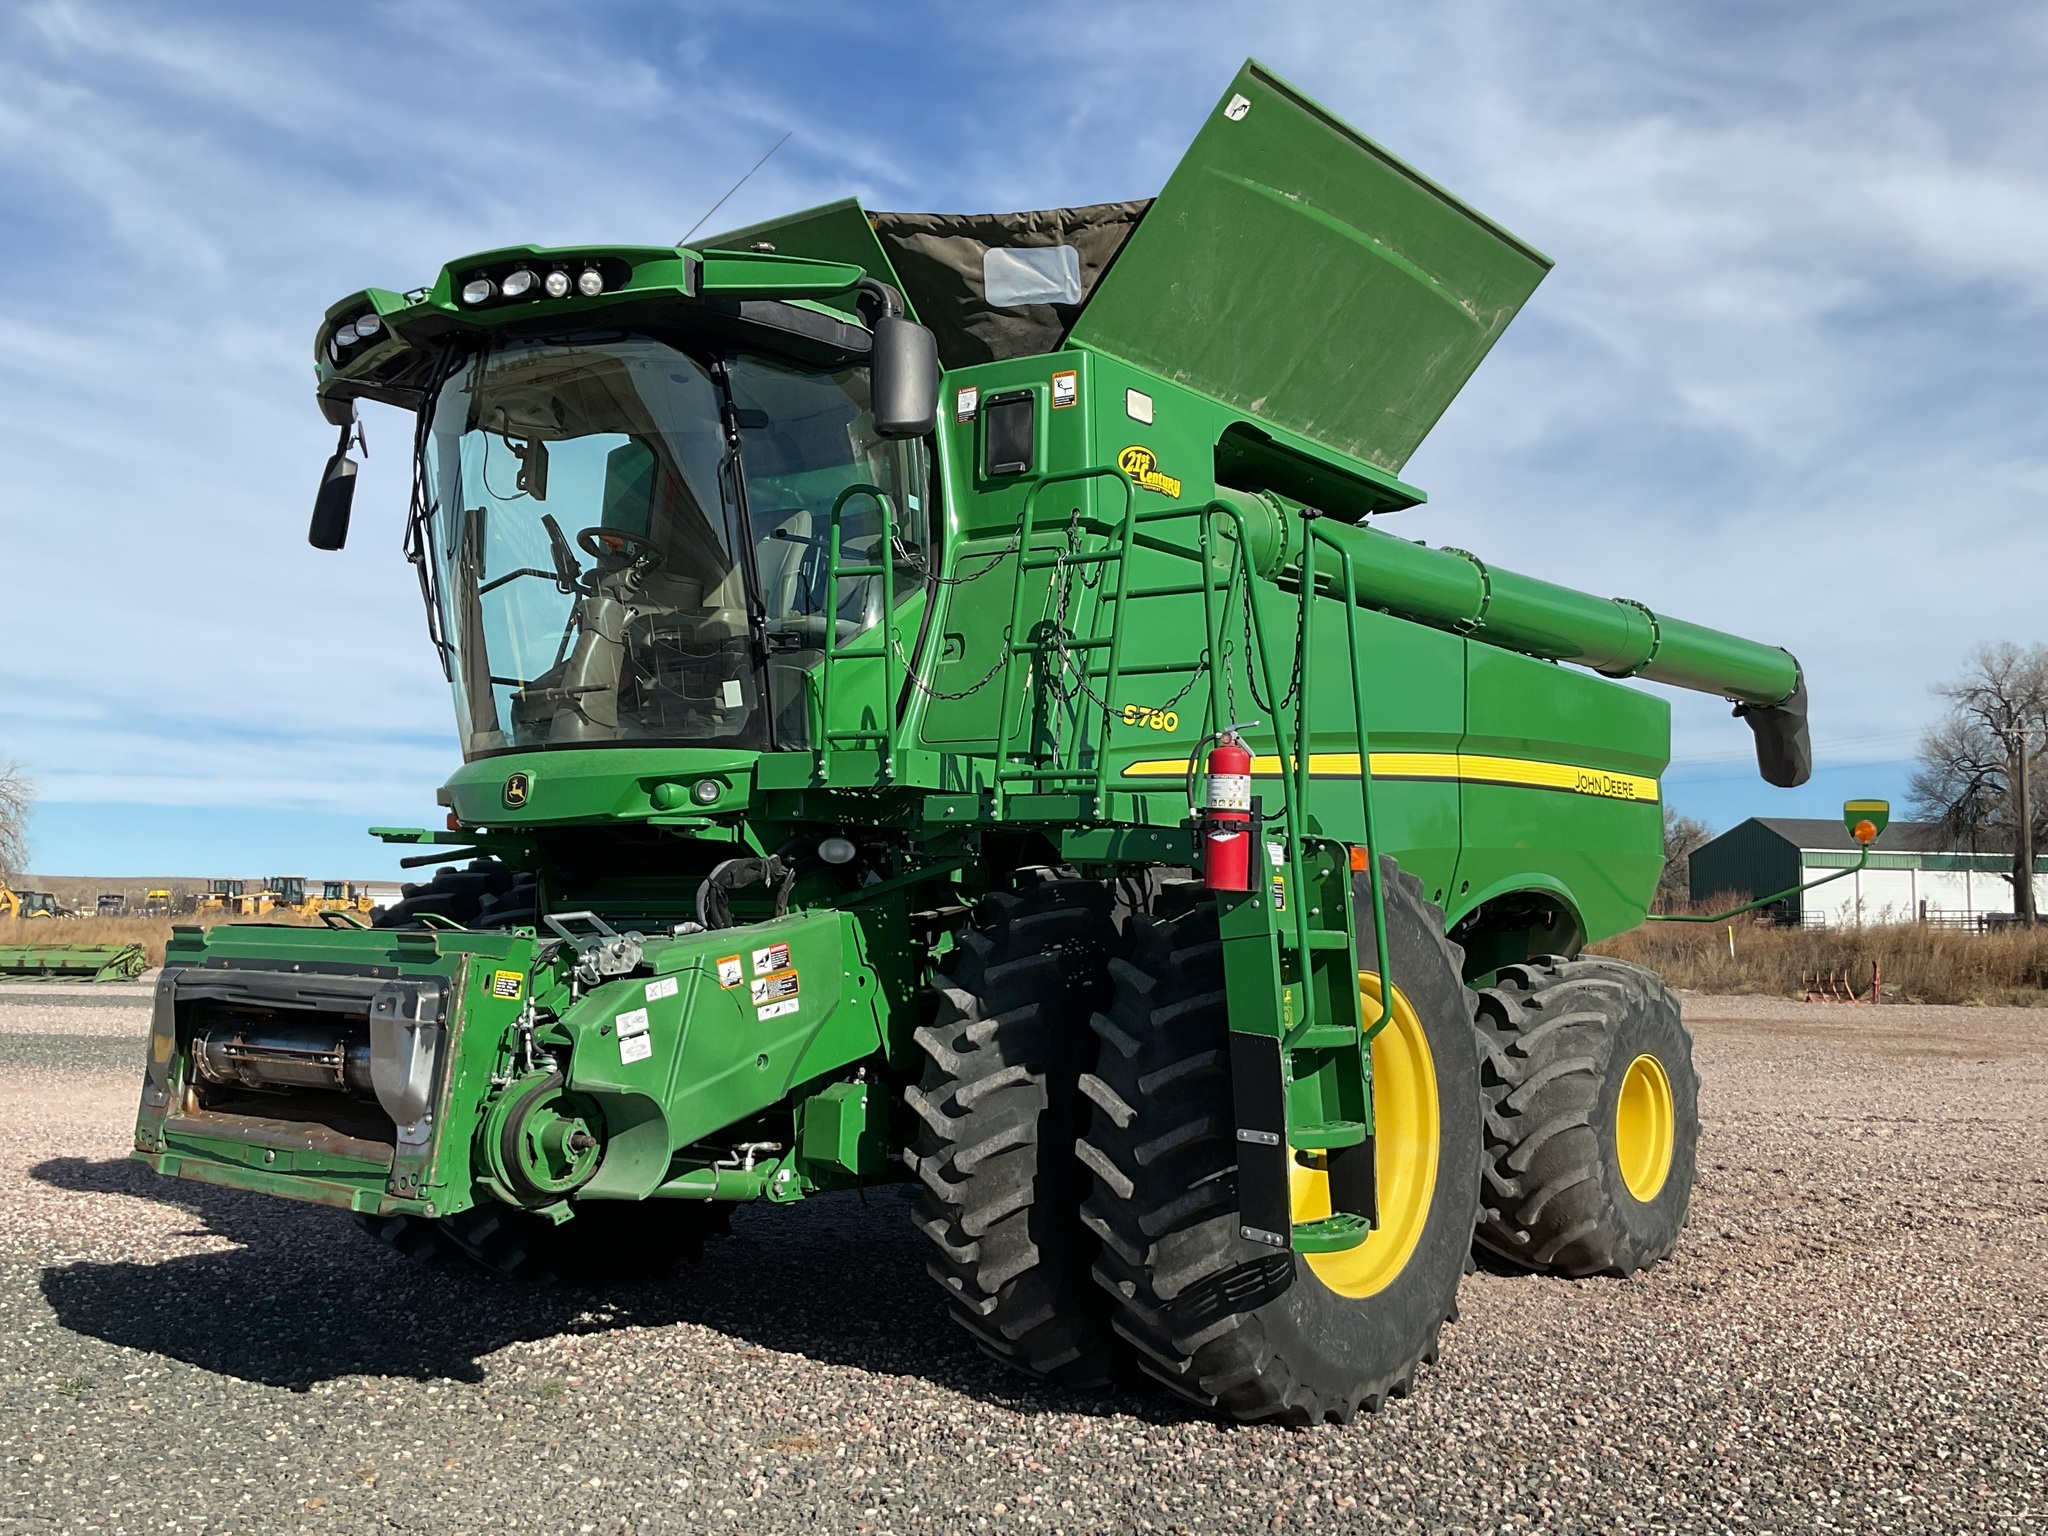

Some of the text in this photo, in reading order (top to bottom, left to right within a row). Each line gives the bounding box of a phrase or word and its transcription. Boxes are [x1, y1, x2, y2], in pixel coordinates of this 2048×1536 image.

[1125, 451, 1150, 472] 21st
[1123, 704, 1178, 732] S780
[1575, 771, 1634, 796] JOHN DEERE
